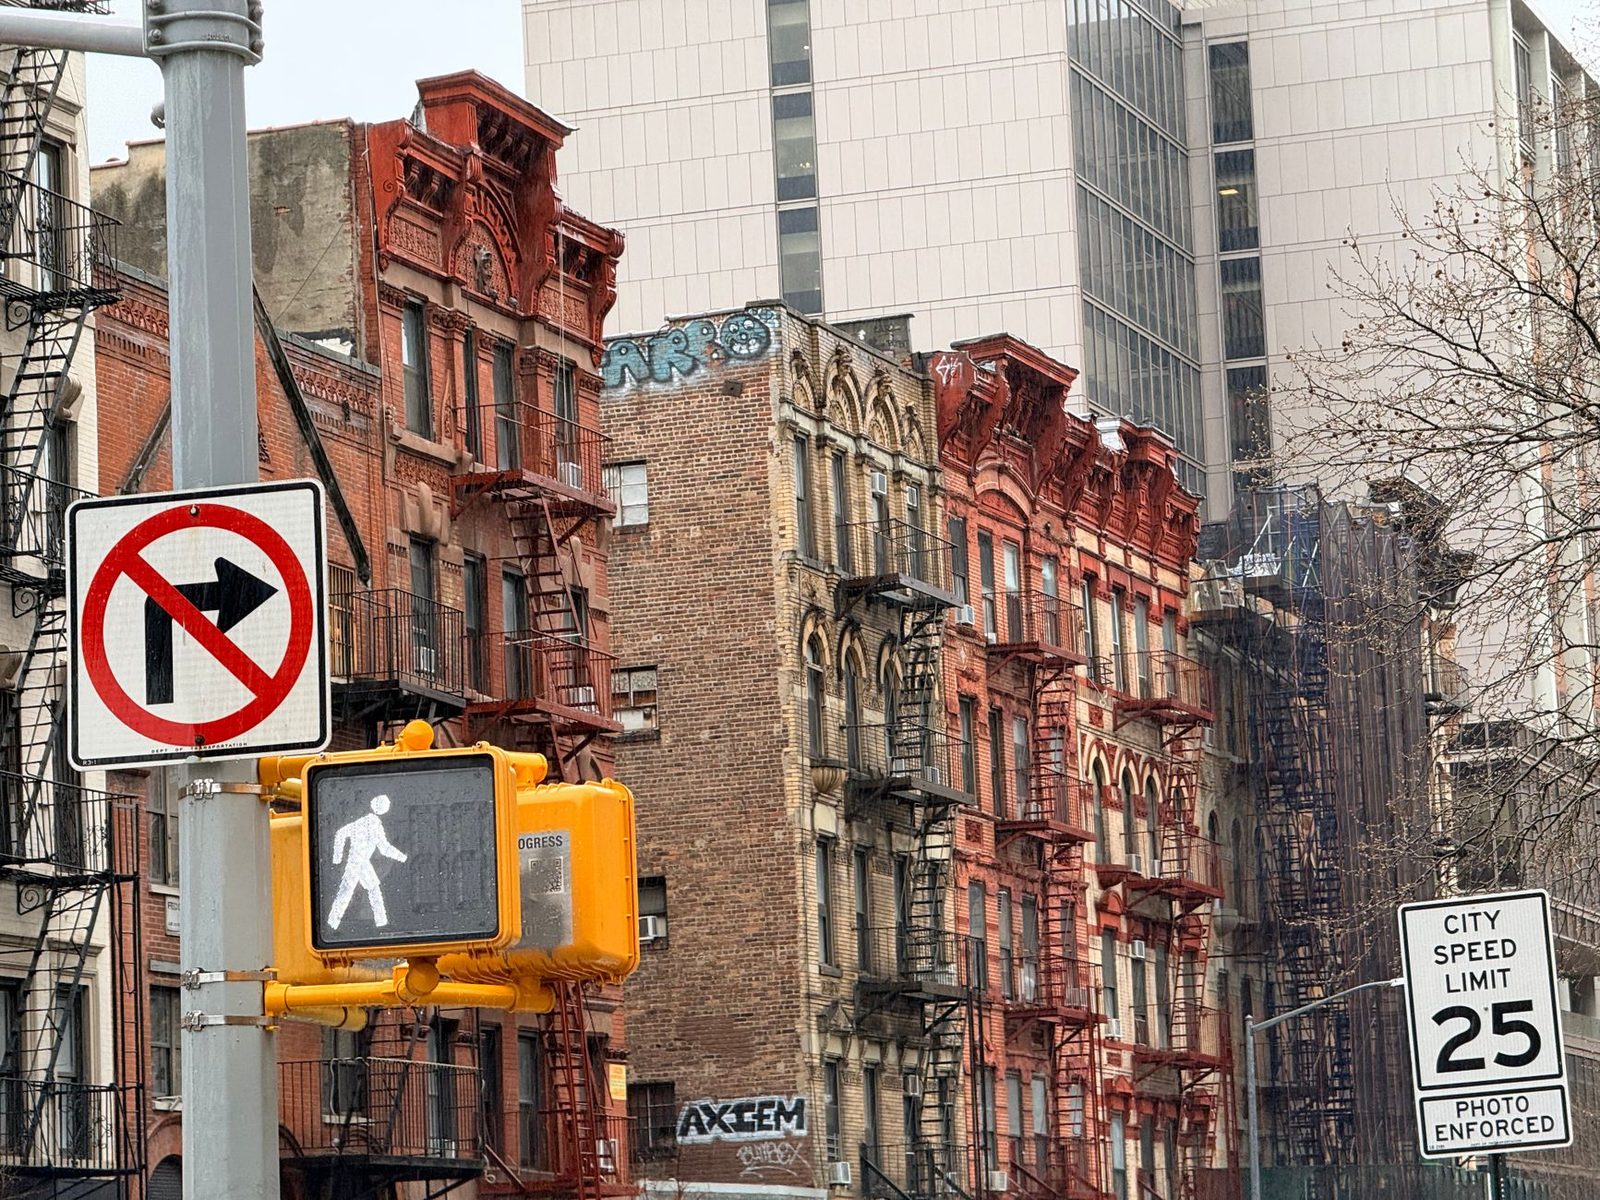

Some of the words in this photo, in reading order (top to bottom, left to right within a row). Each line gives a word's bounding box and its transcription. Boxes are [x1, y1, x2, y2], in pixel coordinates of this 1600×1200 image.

[1444, 910, 1501, 934] CITY
[1433, 938, 1517, 965] SPEED
[1446, 968, 1511, 993] LIMIT
[1431, 999, 1542, 1074] 25
[1456, 1095, 1529, 1118] PHOTO
[1435, 1115, 1555, 1142] ENFORCED
